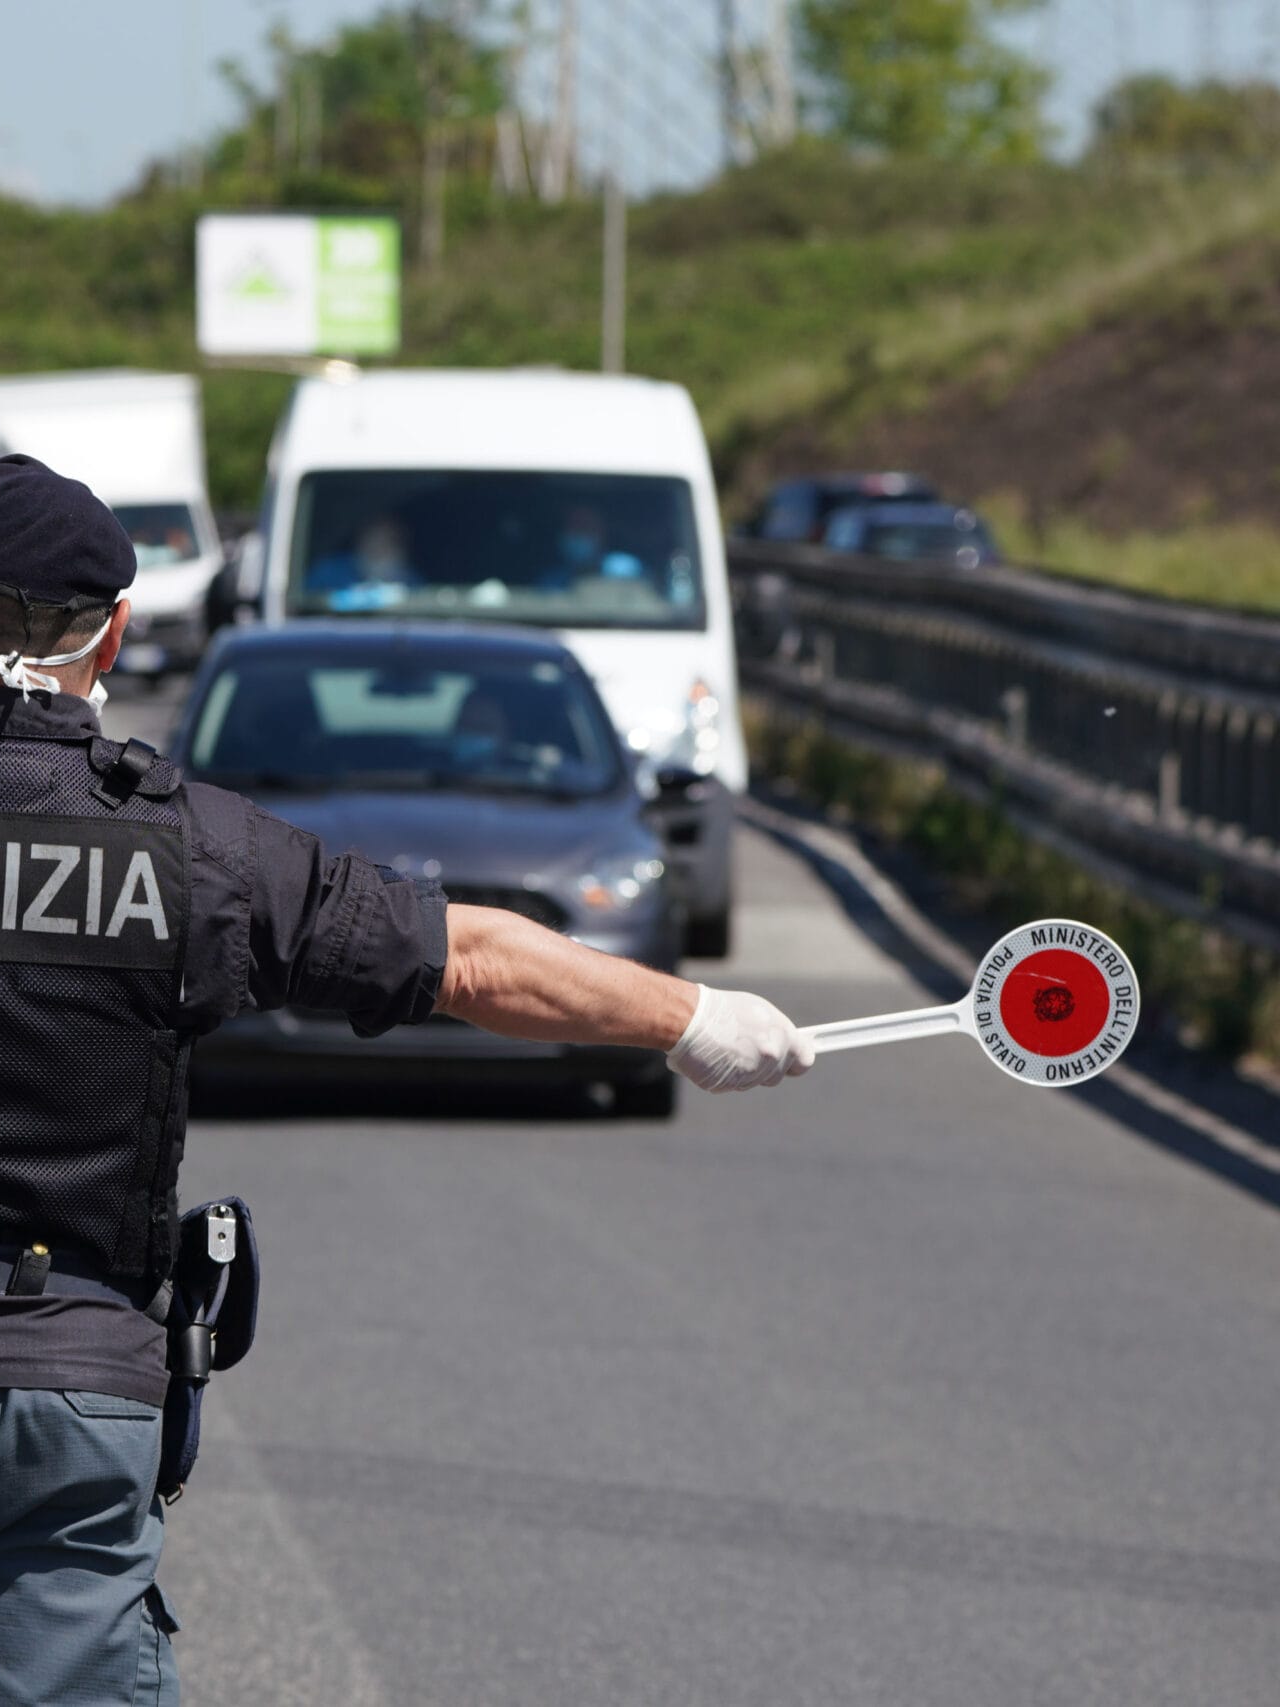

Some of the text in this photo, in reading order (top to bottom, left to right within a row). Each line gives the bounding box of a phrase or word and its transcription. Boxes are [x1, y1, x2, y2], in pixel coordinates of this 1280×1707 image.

[977, 946, 1026, 1073] POLIZIA DI STATO
[1031, 927, 1132, 1080] MINISTERO DELL'INTERNO
